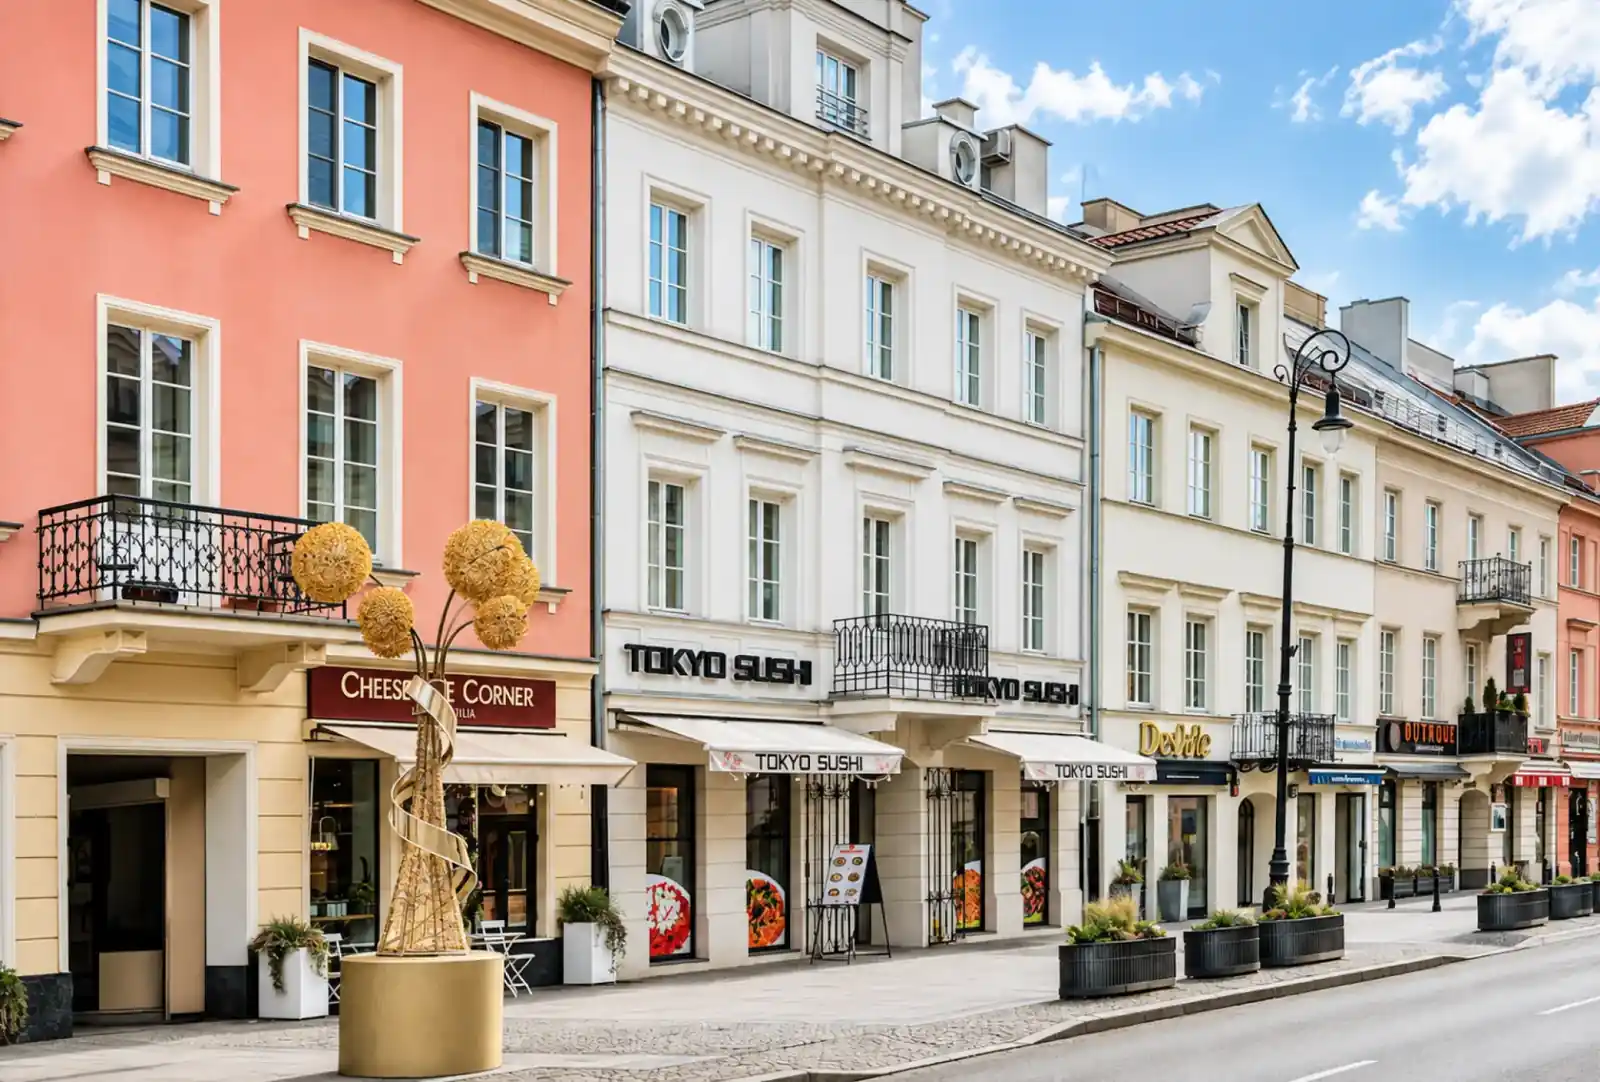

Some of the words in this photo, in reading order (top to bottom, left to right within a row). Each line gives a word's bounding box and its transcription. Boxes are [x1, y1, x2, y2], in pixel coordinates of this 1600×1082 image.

[624, 643, 726, 679] TOKYO
[733, 654, 813, 686] SUSHI
[341, 670, 455, 703] CHEESEE
[463, 679, 534, 707] CORNER
[1023, 680, 1079, 705] SUSHI
[755, 753, 811, 771] TOKYO
[817, 755, 863, 771] SUSHI
[1055, 764, 1093, 778] TOKYO
[1097, 765, 1128, 778] SUSHI
